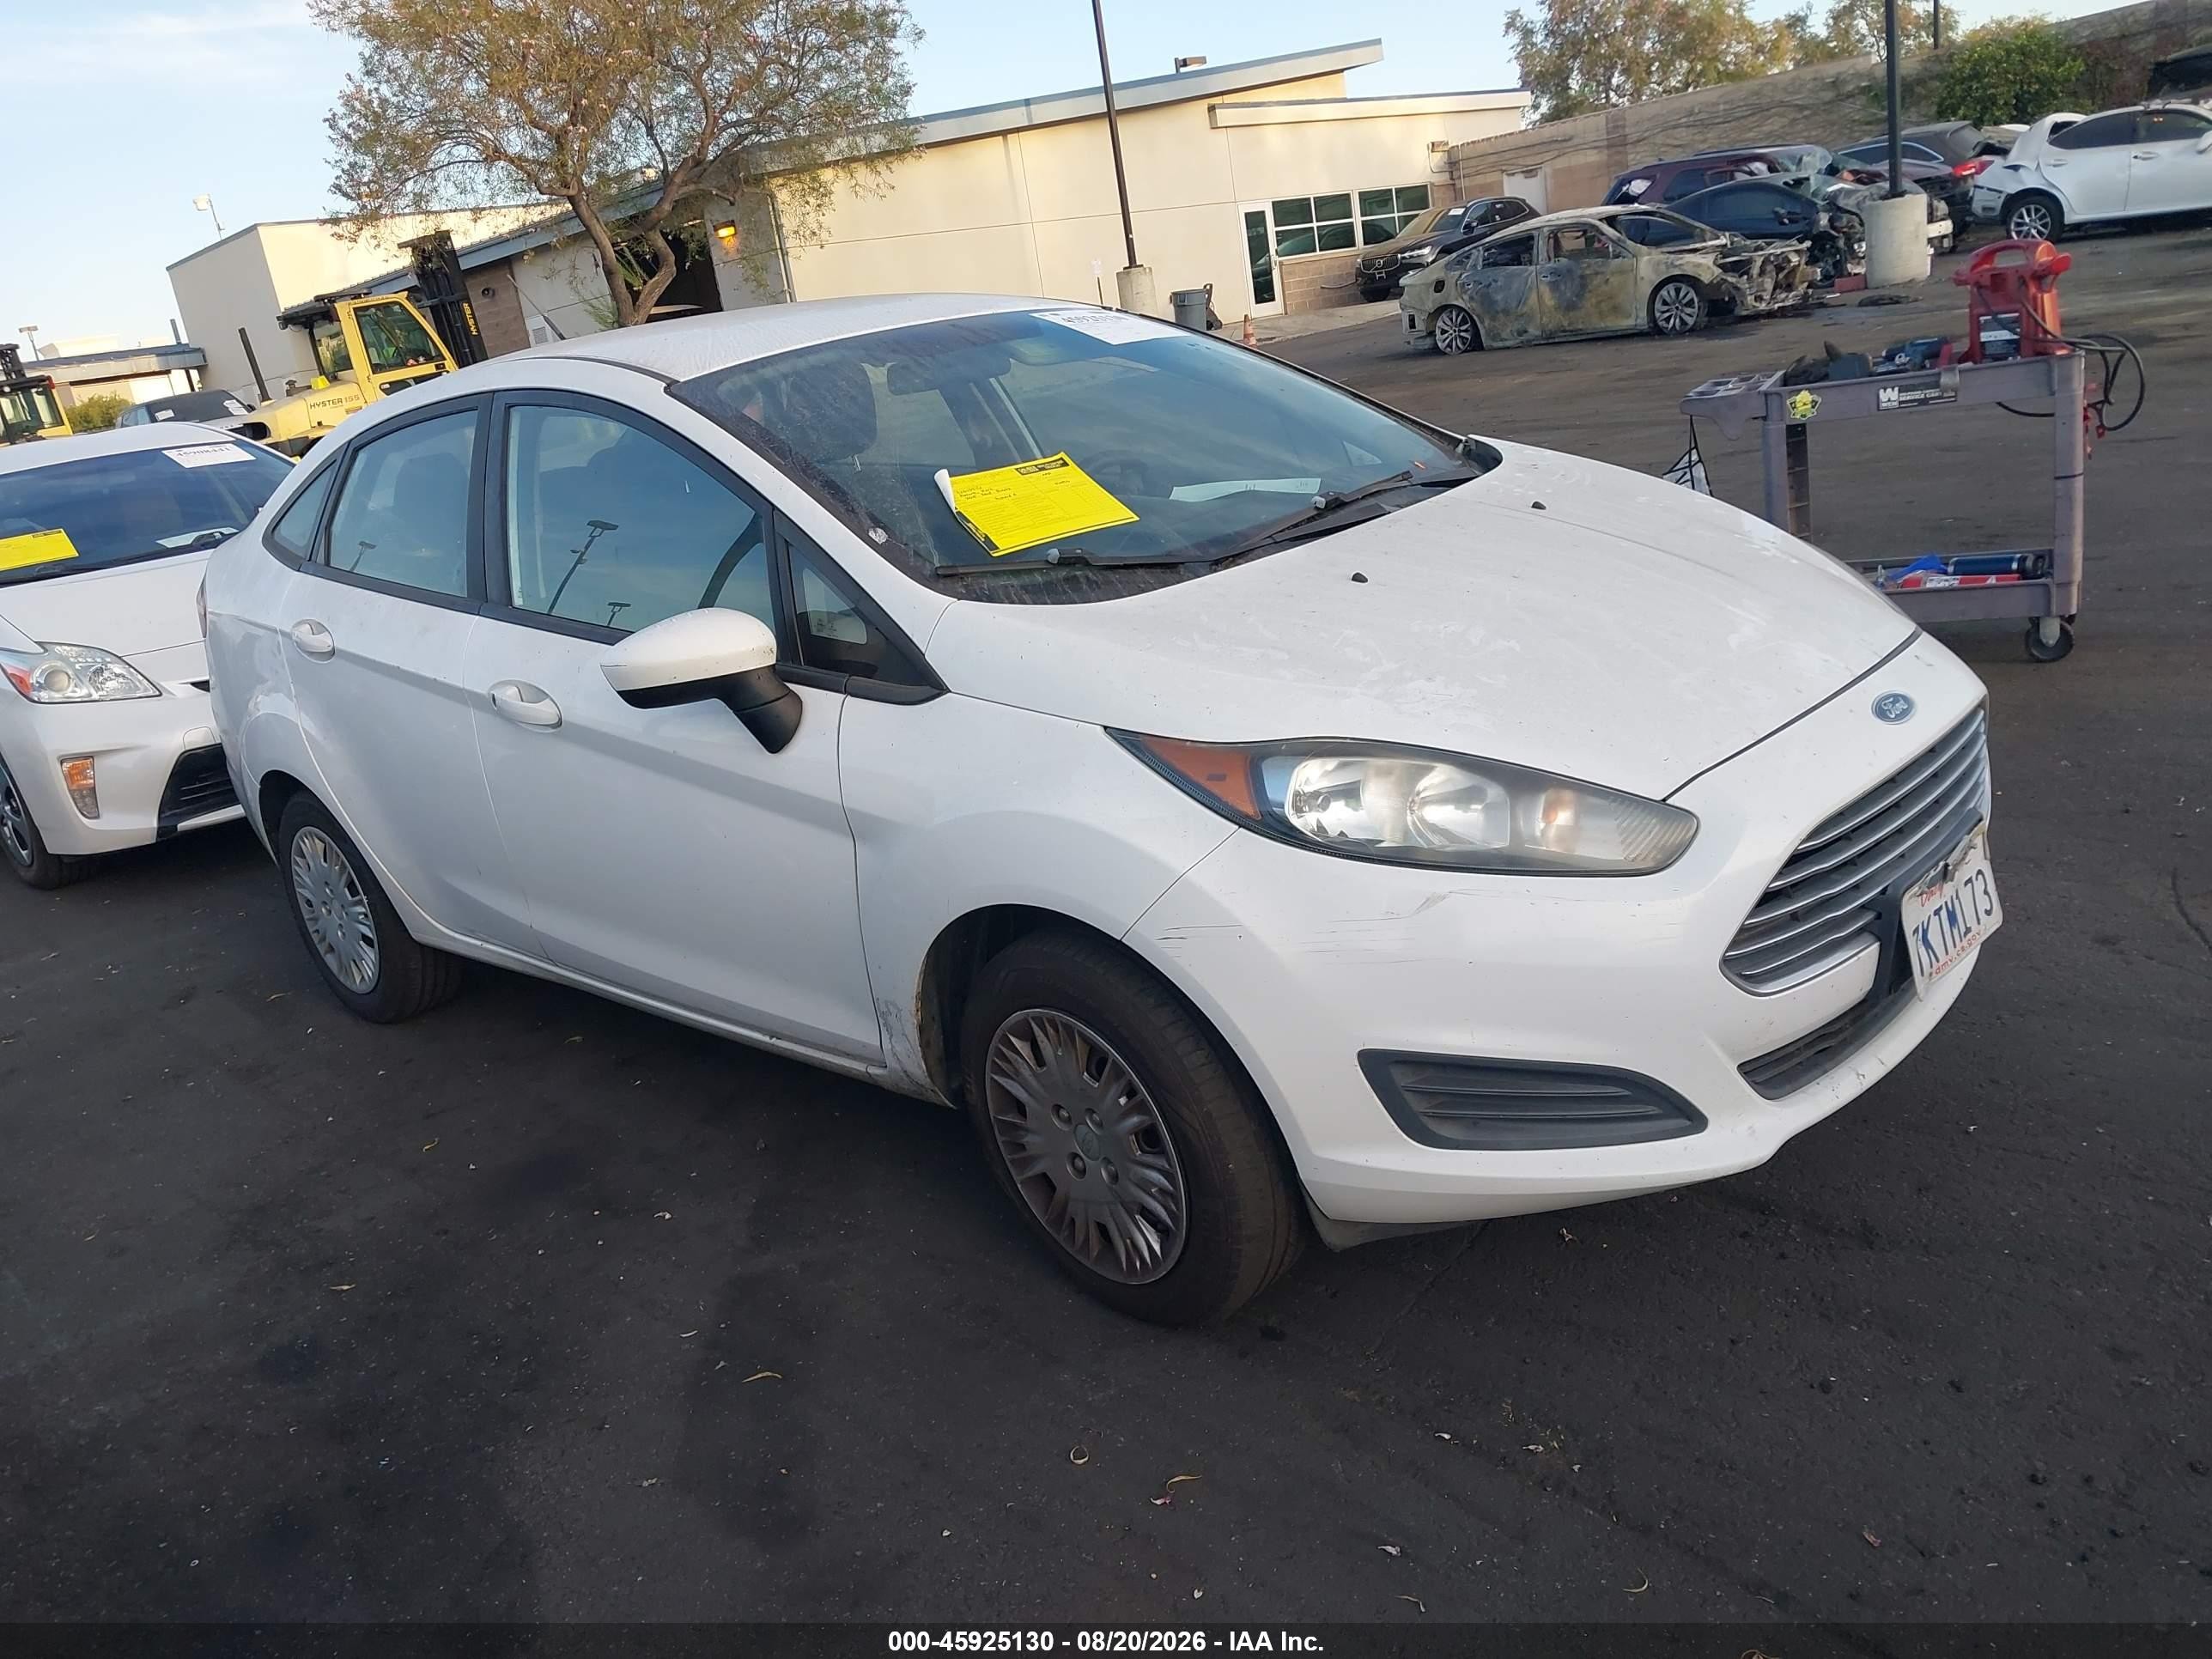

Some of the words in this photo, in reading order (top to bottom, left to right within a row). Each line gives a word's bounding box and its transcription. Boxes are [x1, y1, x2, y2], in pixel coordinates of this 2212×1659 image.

[463, 302, 478, 335] HYSTER
[309, 398, 343, 410] HYSTER
[1881, 696, 1908, 718] Ford
[1911, 868, 1994, 977] 7KTM173
[1934, 930, 1982, 976] dmv.ca.gov
